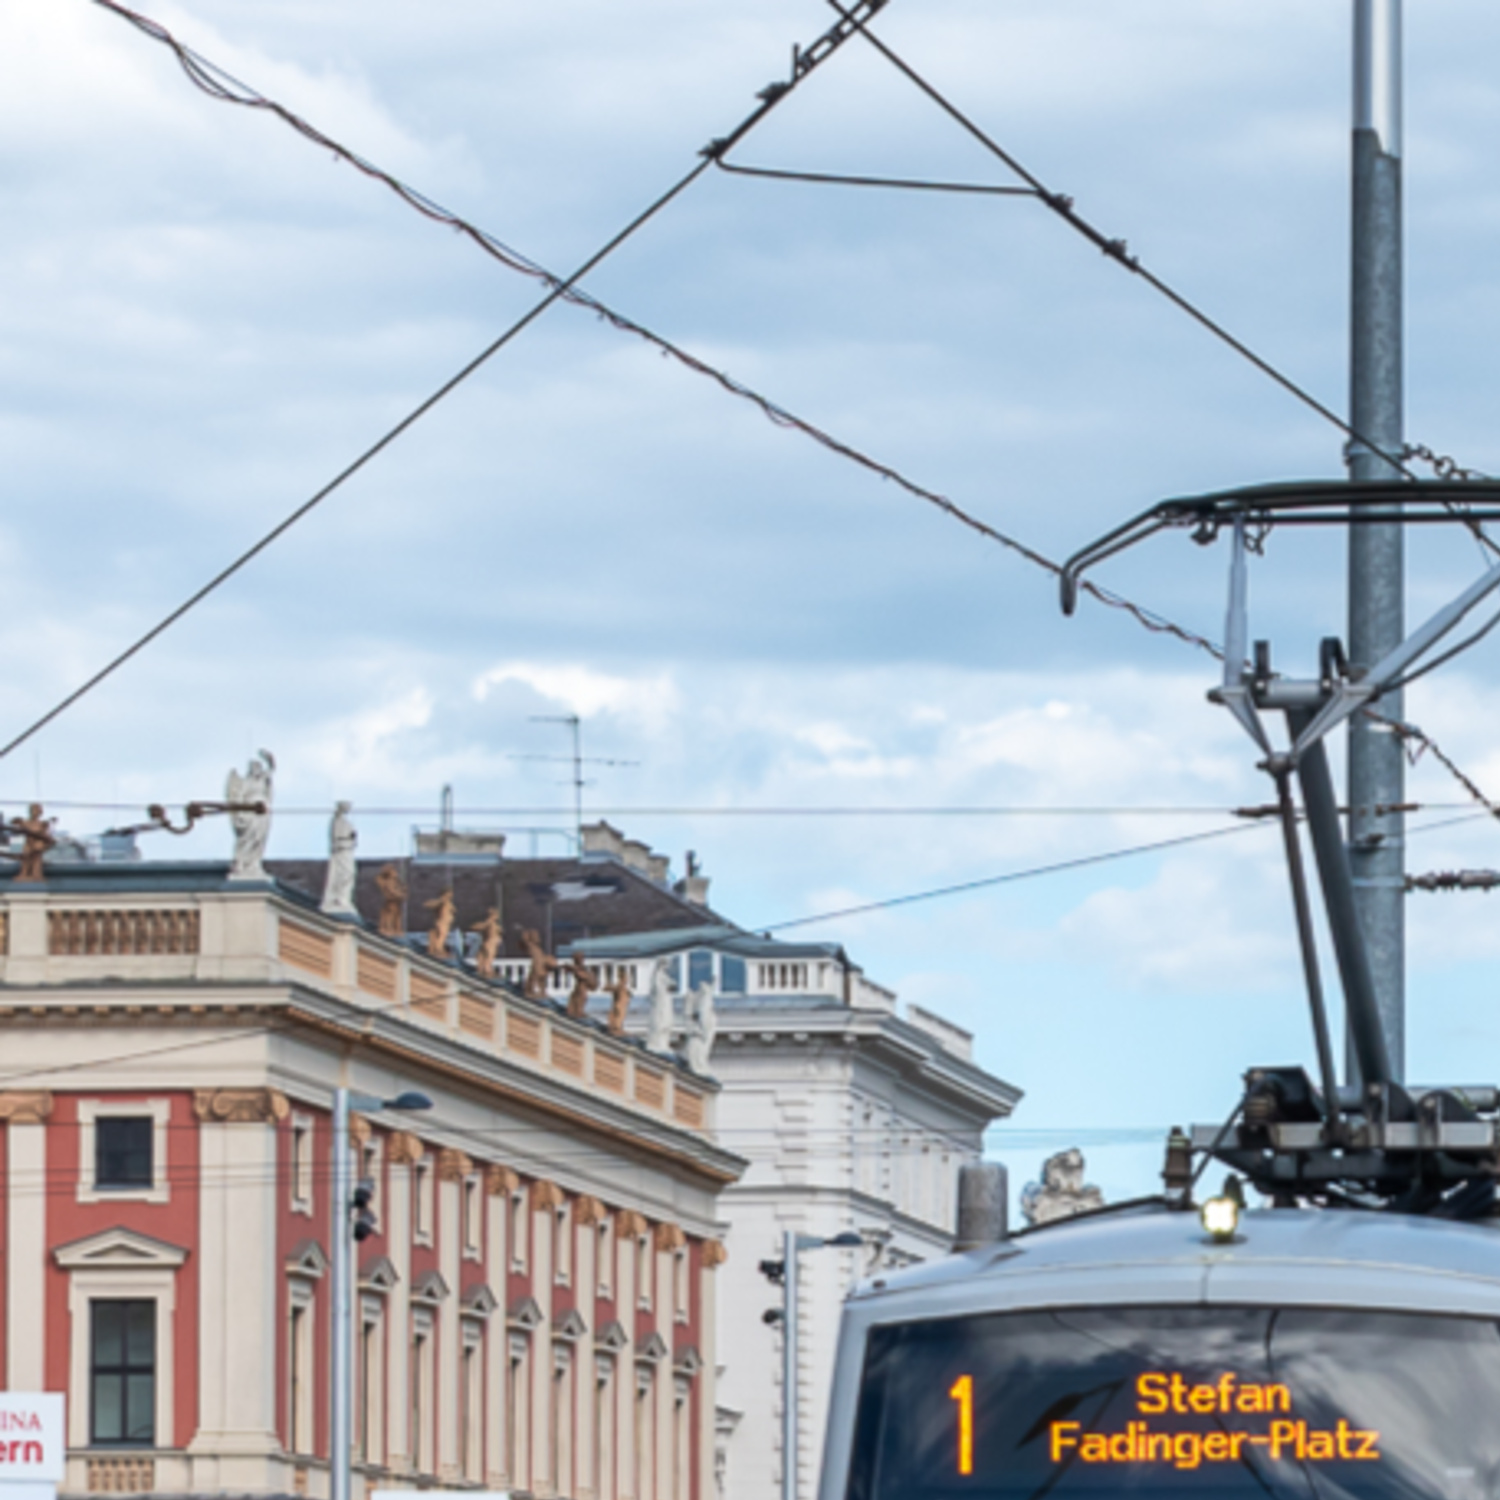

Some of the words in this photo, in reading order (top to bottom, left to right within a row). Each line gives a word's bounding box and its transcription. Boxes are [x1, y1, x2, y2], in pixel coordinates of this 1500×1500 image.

[1136, 1372, 1291, 1414] Stefan
[949, 1374, 974, 1475] 1
[1049, 1419, 1381, 1468] Fadinger-Platz
